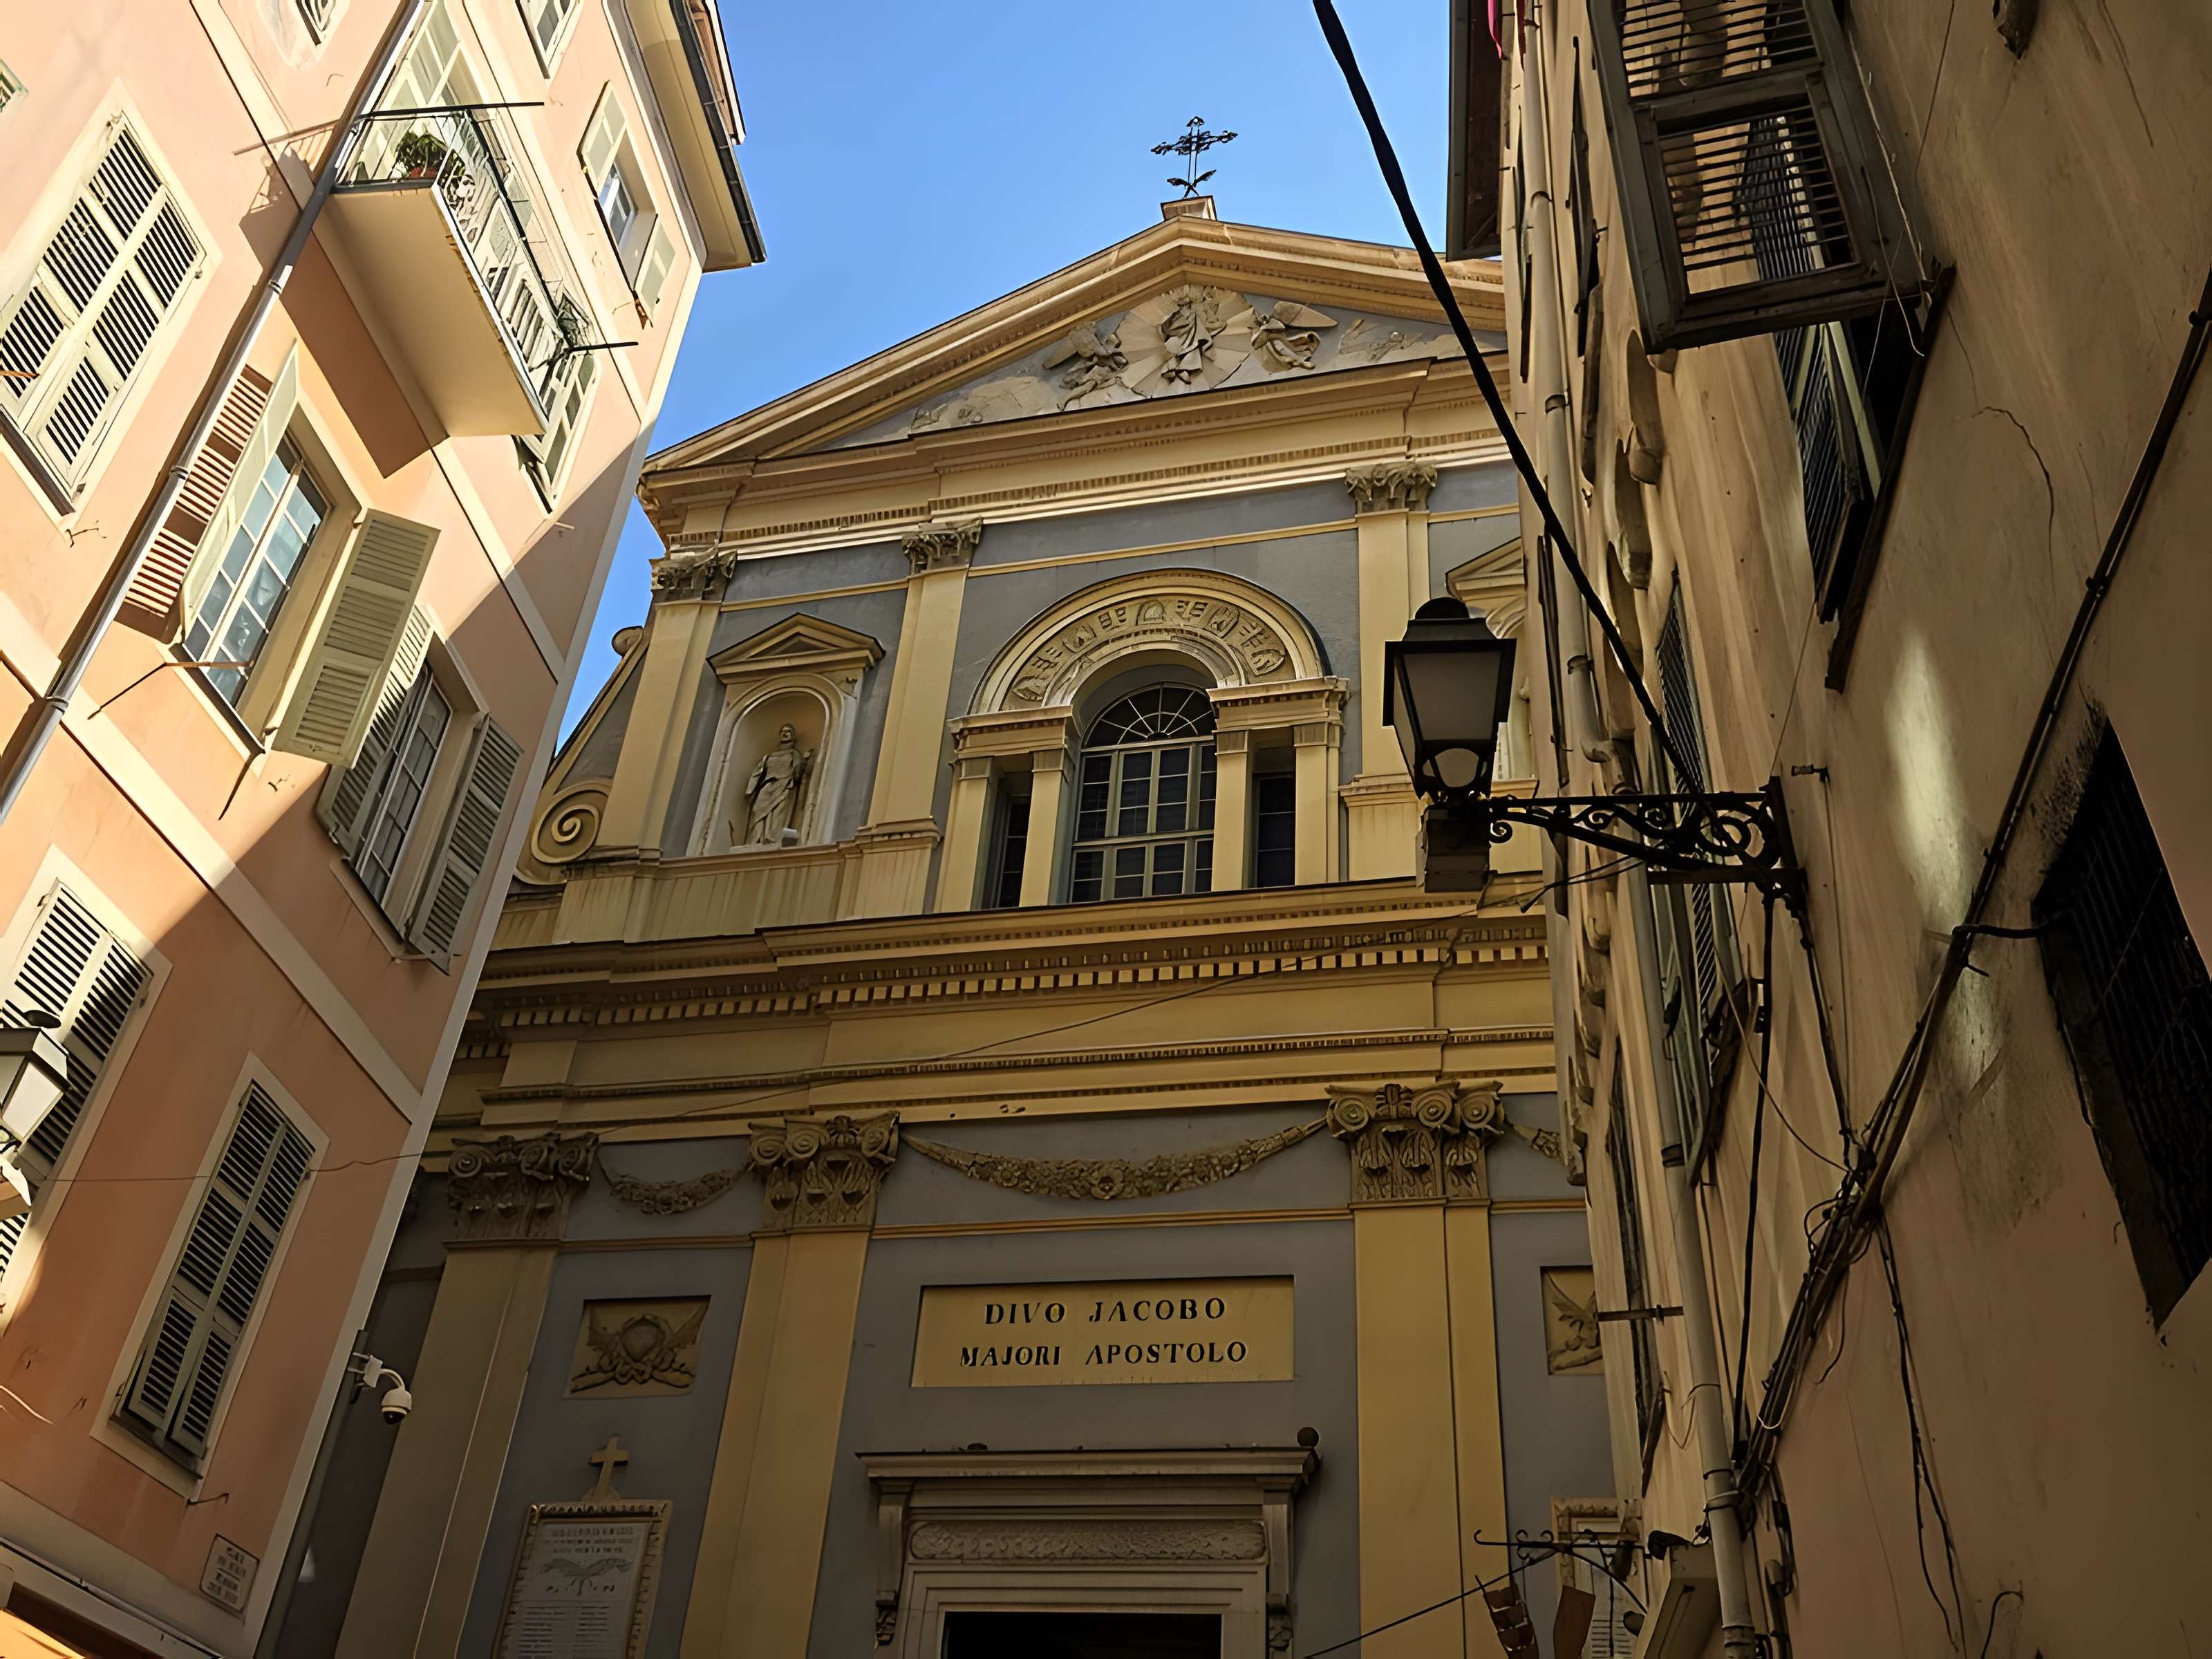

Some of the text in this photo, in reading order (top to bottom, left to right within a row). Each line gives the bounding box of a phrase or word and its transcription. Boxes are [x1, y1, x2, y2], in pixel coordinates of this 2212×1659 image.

[985, 1297, 1226, 1324] DIVO JACOBO
[960, 1340, 1247, 1367] MAJORI APOSTOLO
